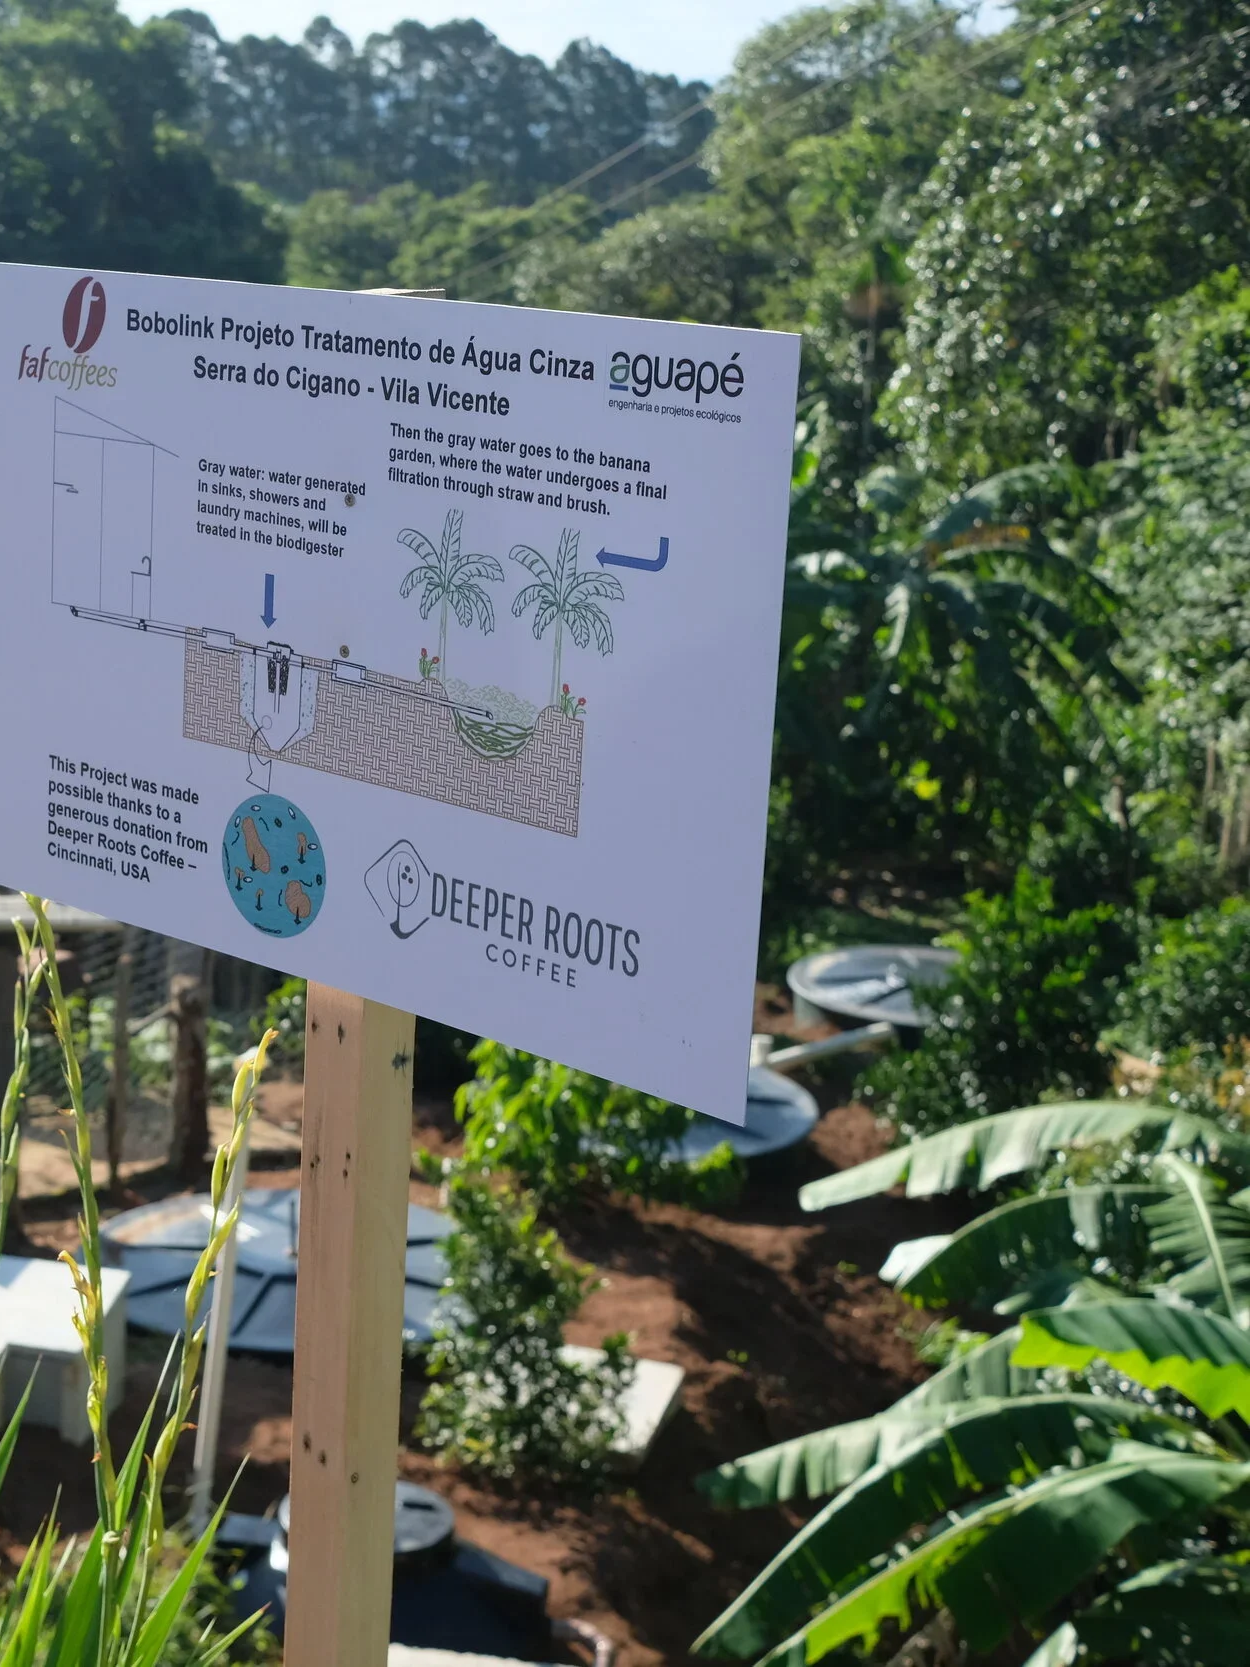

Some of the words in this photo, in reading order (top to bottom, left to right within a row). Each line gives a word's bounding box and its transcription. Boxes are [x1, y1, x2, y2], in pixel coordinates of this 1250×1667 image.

[126, 308, 215, 339] Bobolink
[221, 317, 294, 350] Projeto
[301, 325, 422, 361] Tratamento
[428, 339, 455, 365] de
[461, 335, 521, 375] Água
[529, 348, 595, 381] Cinza
[193, 355, 246, 384] Serra
[253, 363, 279, 387] do
[286, 365, 360, 398] Cigano
[380, 376, 420, 405] Vila
[427, 381, 510, 416] Vicente
[609, 351, 744, 403] aguapé
[608, 399, 652, 412] engenharia
[654, 405, 660, 413] e
[661, 405, 694, 418] projetos
[695, 409, 741, 423] ecológicos
[390, 423, 421, 440] Then
[424, 427, 444, 443] the
[448, 432, 476, 451] gray
[480, 437, 516, 453] water
[519, 443, 551, 459] goes
[556, 446, 569, 461] to
[573, 447, 595, 465] the
[599, 451, 651, 473] banana
[197, 479, 208, 493] in
[211, 482, 246, 501] sinks,
[249, 487, 300, 507] showers
[303, 498, 326, 511] and
[198, 459, 226, 477] Gray
[229, 465, 265, 480] water:
[269, 470, 301, 486] water
[305, 475, 366, 496] generated
[388, 448, 436, 467] garden,
[439, 454, 478, 471] where
[482, 459, 502, 474] the
[506, 463, 542, 481] water
[546, 468, 619, 494] undergoes
[624, 481, 632, 494] a
[636, 481, 667, 500] final
[388, 467, 439, 488] filtration
[443, 477, 494, 499] through
[498, 485, 534, 503] straw
[537, 491, 562, 508] and
[566, 494, 611, 515] brush.
[197, 500, 240, 521] laundry
[244, 509, 304, 532] machines,
[308, 518, 329, 534] will
[332, 521, 347, 536] be
[197, 520, 237, 539] treated
[240, 527, 250, 542] in
[254, 530, 273, 545] the
[276, 533, 344, 558] biodigester
[48, 779, 104, 804] possible
[107, 791, 152, 816] thanks
[156, 804, 170, 820] to
[173, 811, 181, 824] a
[49, 754, 76, 774] This
[80, 762, 128, 787] Project
[131, 777, 157, 794] was
[161, 784, 199, 805] made
[48, 801, 109, 827] generous
[113, 816, 172, 844] donation
[176, 831, 208, 853] from
[48, 820, 94, 845] Deeper
[97, 832, 136, 856] Roots
[140, 844, 185, 869] Coffee
[47, 842, 117, 876] Cincinnati,
[121, 860, 150, 882] USA
[431, 872, 534, 945] DEEPER
[544, 905, 640, 977] ROOTS
[485, 943, 577, 988] COFFEE
